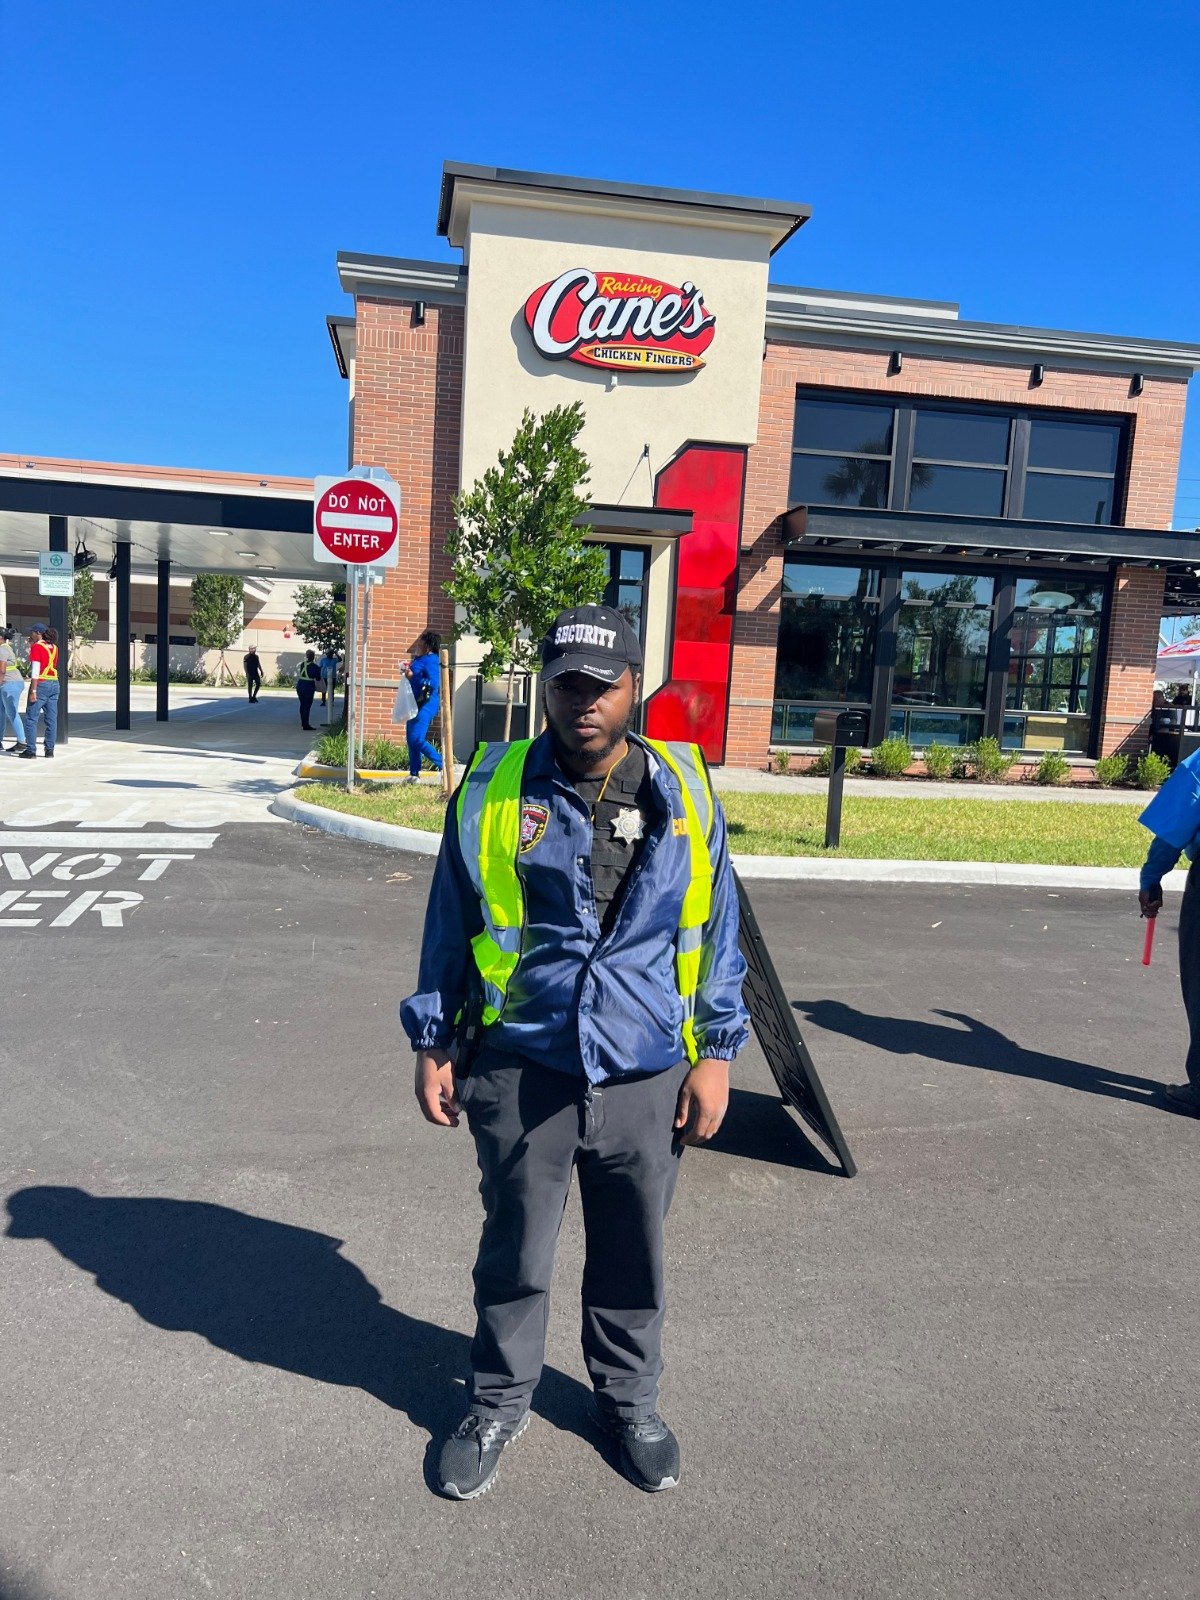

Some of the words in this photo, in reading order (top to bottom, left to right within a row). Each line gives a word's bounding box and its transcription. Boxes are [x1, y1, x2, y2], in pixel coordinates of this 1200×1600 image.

[600, 276, 662, 298] Raising
[533, 267, 717, 357] Cane's
[593, 347, 641, 361] CHICKEN
[645, 351, 694, 366] FINGERS
[328, 494, 349, 509] DO
[358, 496, 387, 512] NOT
[333, 532, 380, 549] ENTER
[554, 623, 617, 649] SECURITY
[0, 798, 241, 828] STO
[0, 852, 196, 881] NOT
